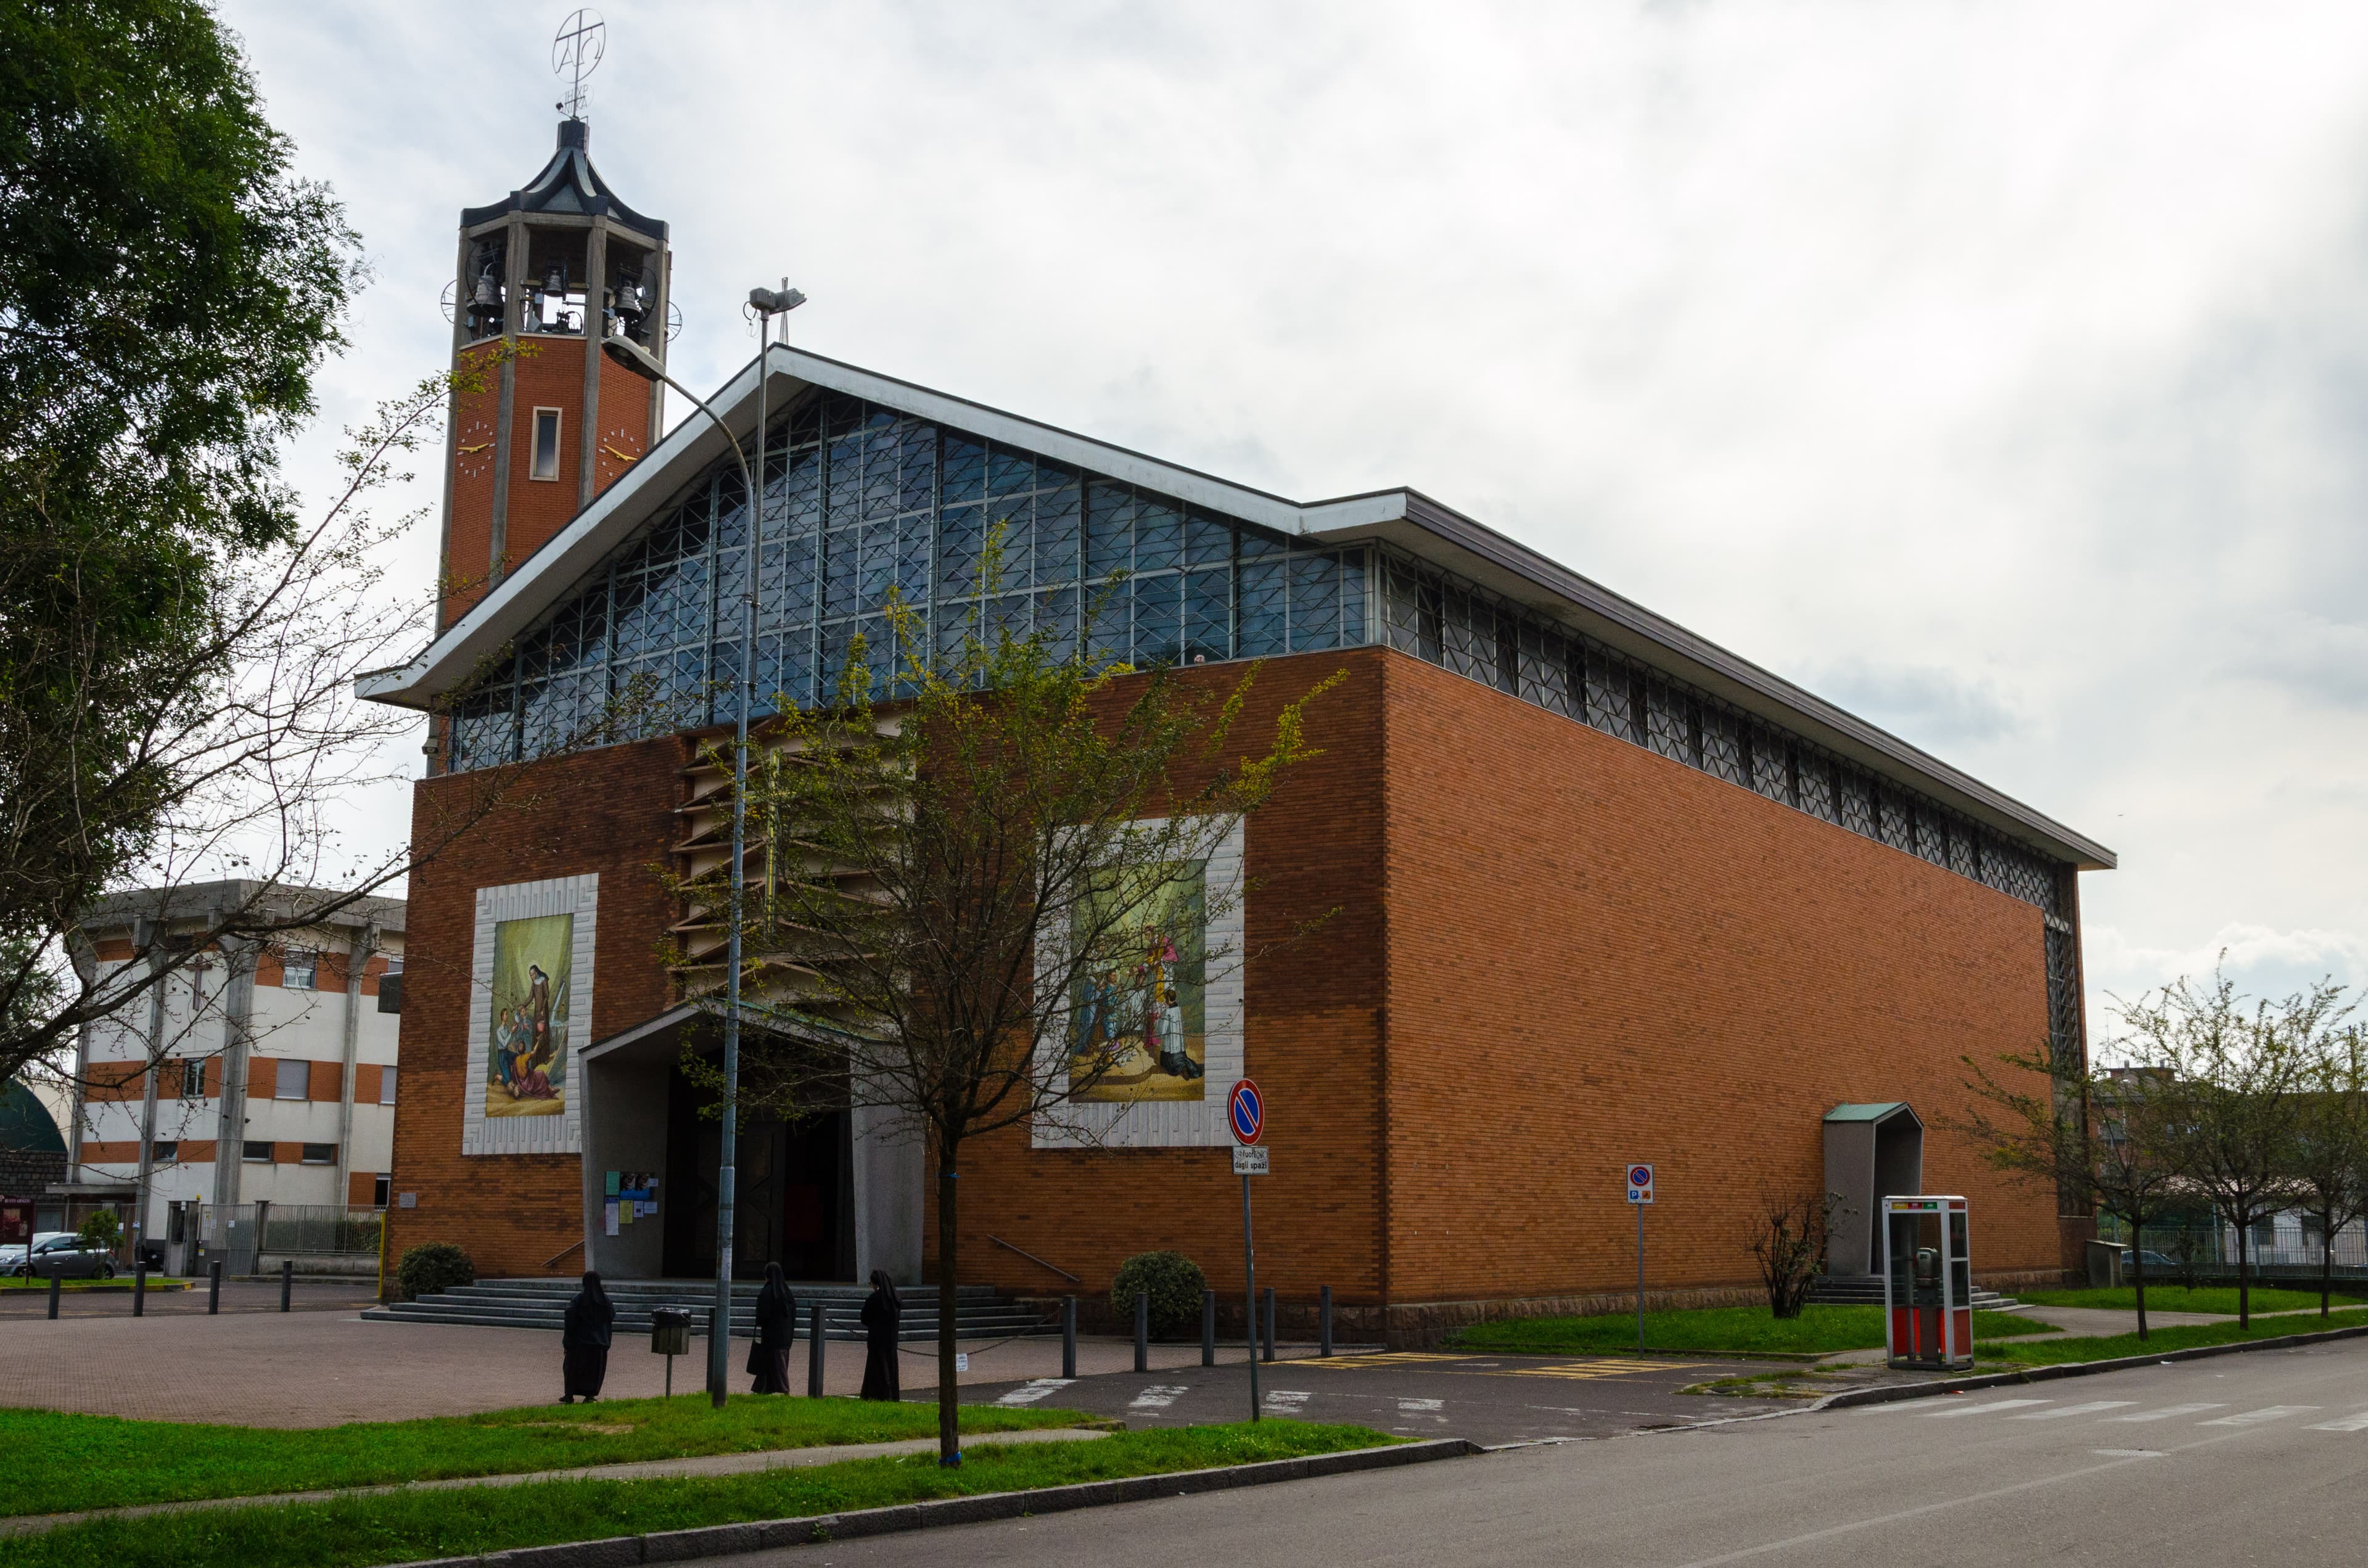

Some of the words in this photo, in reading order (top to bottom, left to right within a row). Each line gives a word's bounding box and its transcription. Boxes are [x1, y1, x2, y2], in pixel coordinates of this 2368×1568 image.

[1243, 1150, 1256, 1158] fuori
[1235, 1160, 1248, 1170] dagli
[1251, 1161, 1267, 1170] spazi
